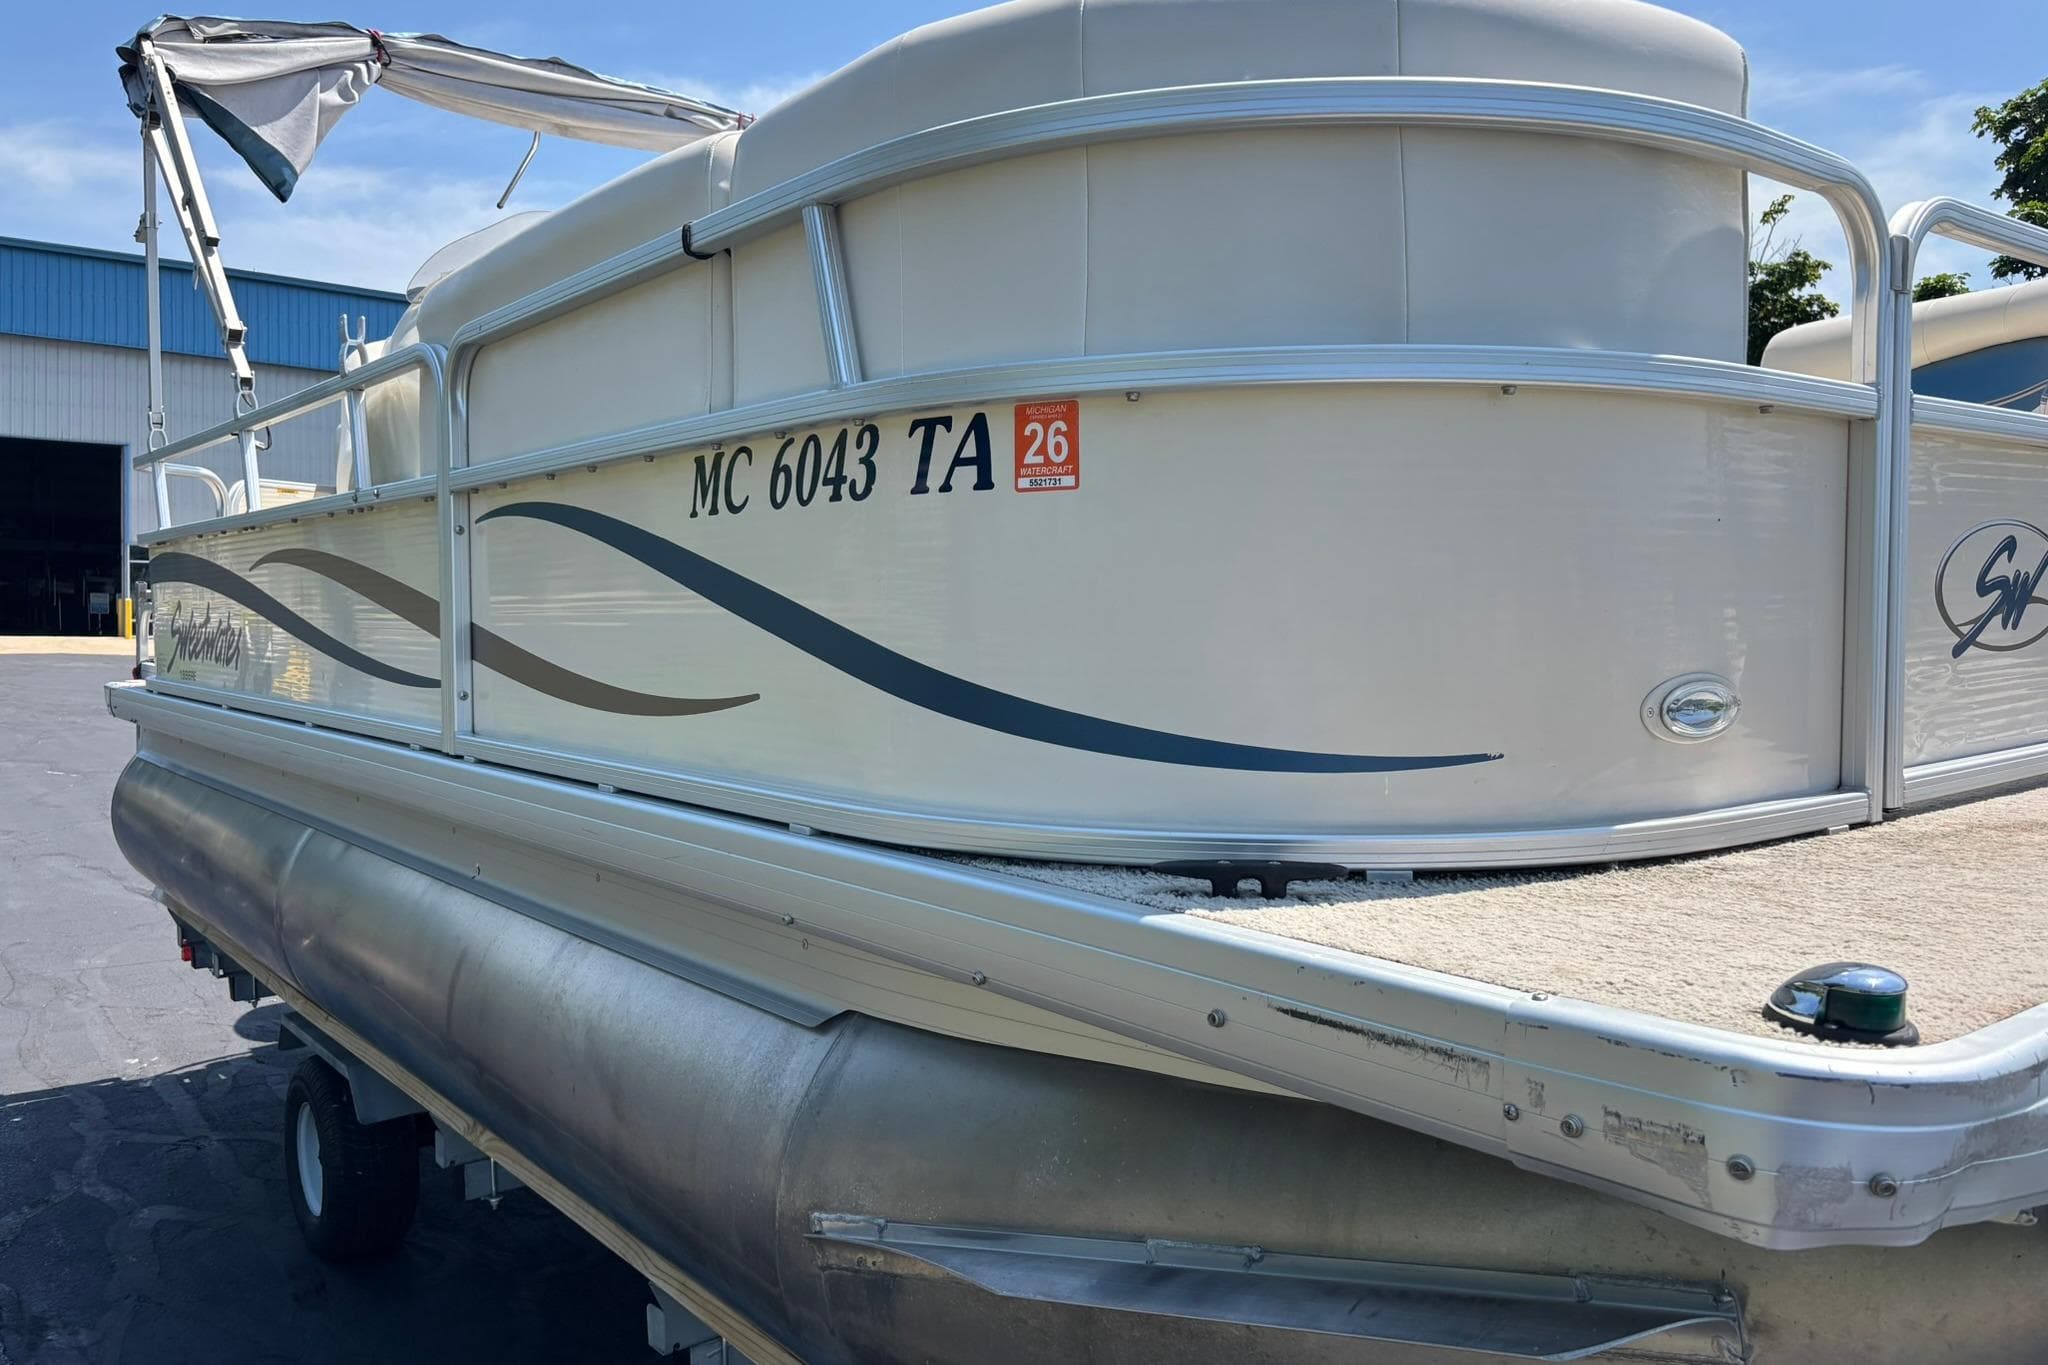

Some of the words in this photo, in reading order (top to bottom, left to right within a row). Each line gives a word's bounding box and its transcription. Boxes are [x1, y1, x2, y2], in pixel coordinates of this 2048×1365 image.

[1025, 404, 1067, 416] MICHIGAN
[1023, 420, 1069, 464] 26
[689, 445, 753, 518] MC
[769, 424, 880, 510] 6043
[908, 412, 995, 496] TA
[1020, 465, 1074, 477] WATERCRAFT
[1029, 478, 1062, 487] 5521731
[167, 600, 242, 673] Sweetwater
